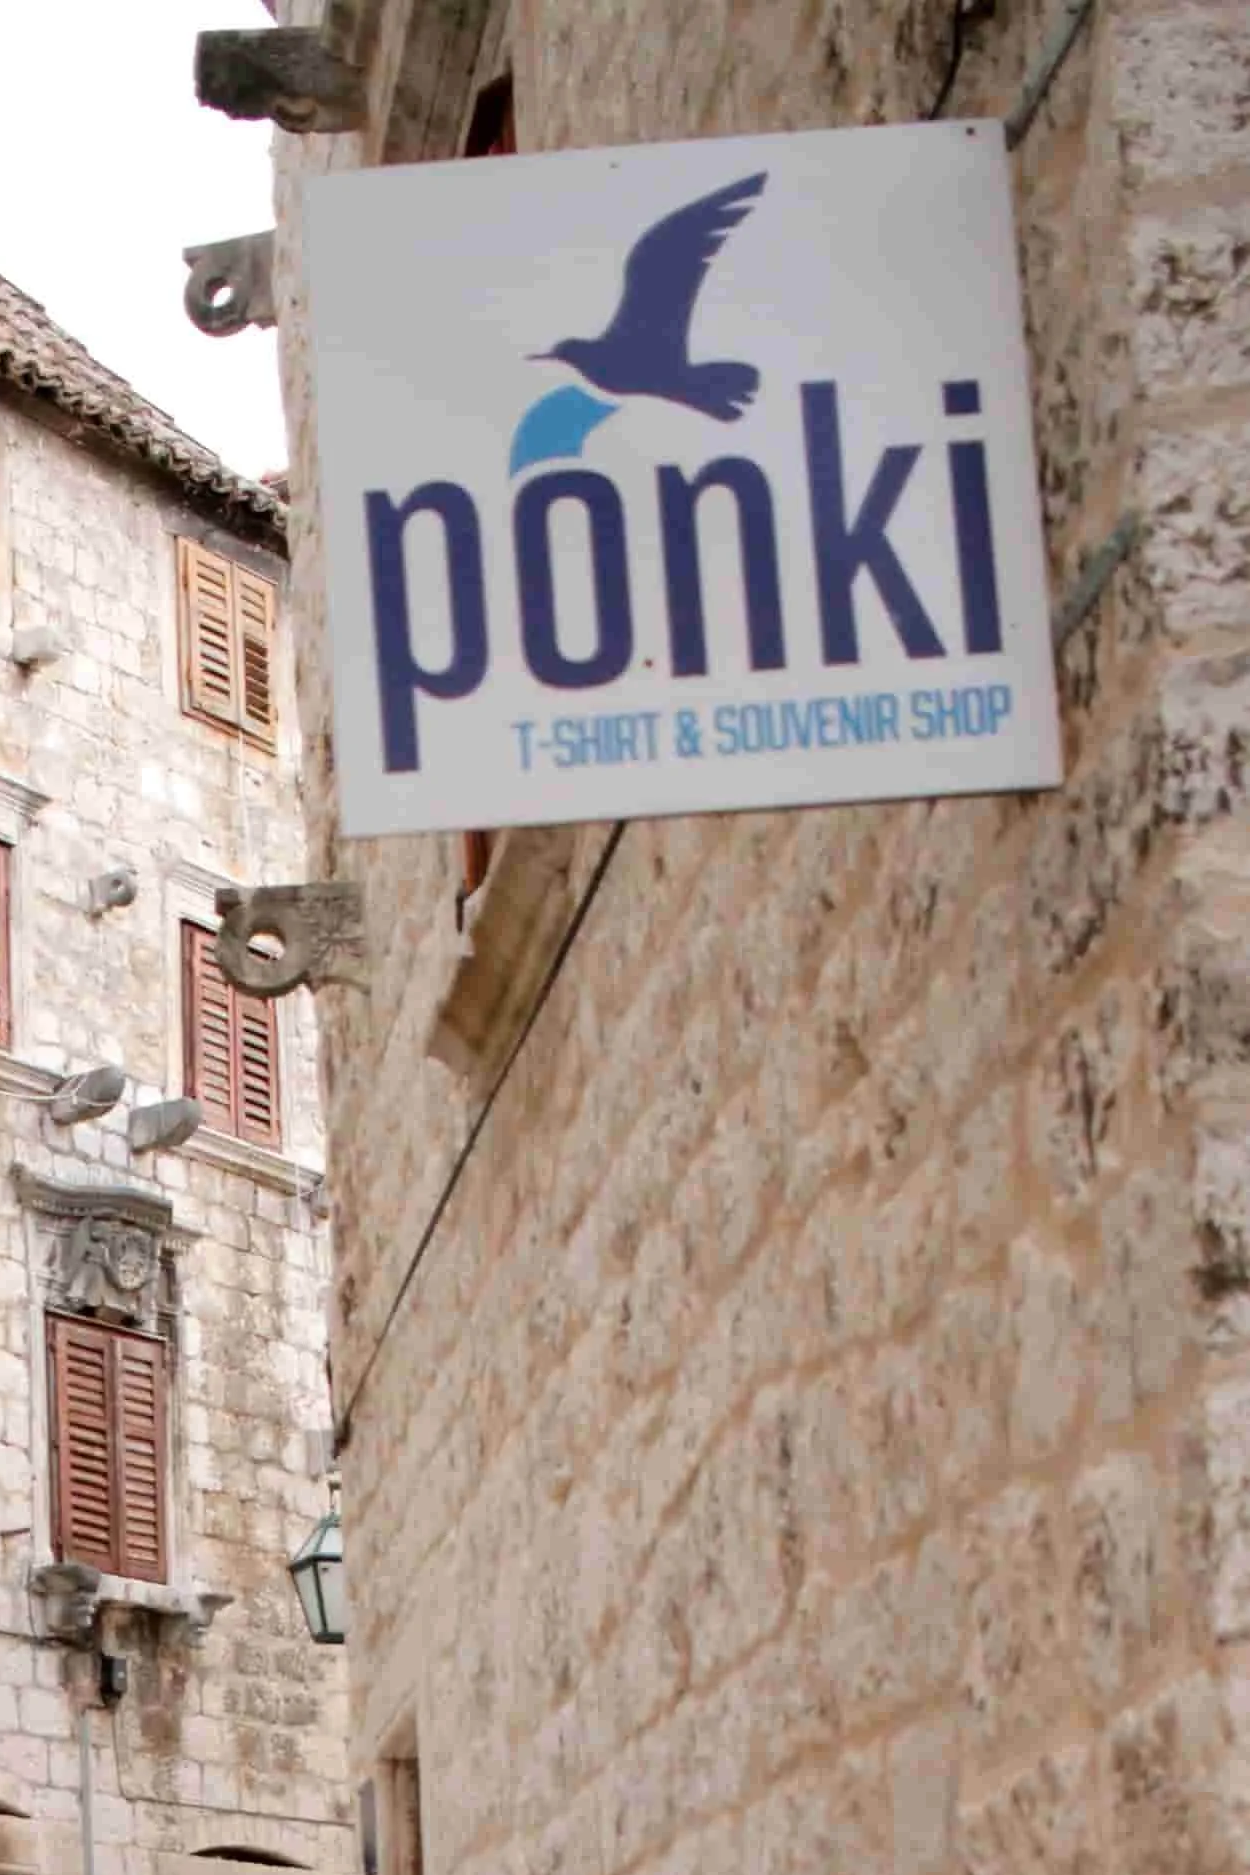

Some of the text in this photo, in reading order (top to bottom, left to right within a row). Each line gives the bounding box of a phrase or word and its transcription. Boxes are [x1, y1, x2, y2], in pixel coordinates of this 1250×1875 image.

[364, 378, 1003, 774] ponki
[511, 684, 1014, 771] T-SHIRT & SOUVENIR SHOP
